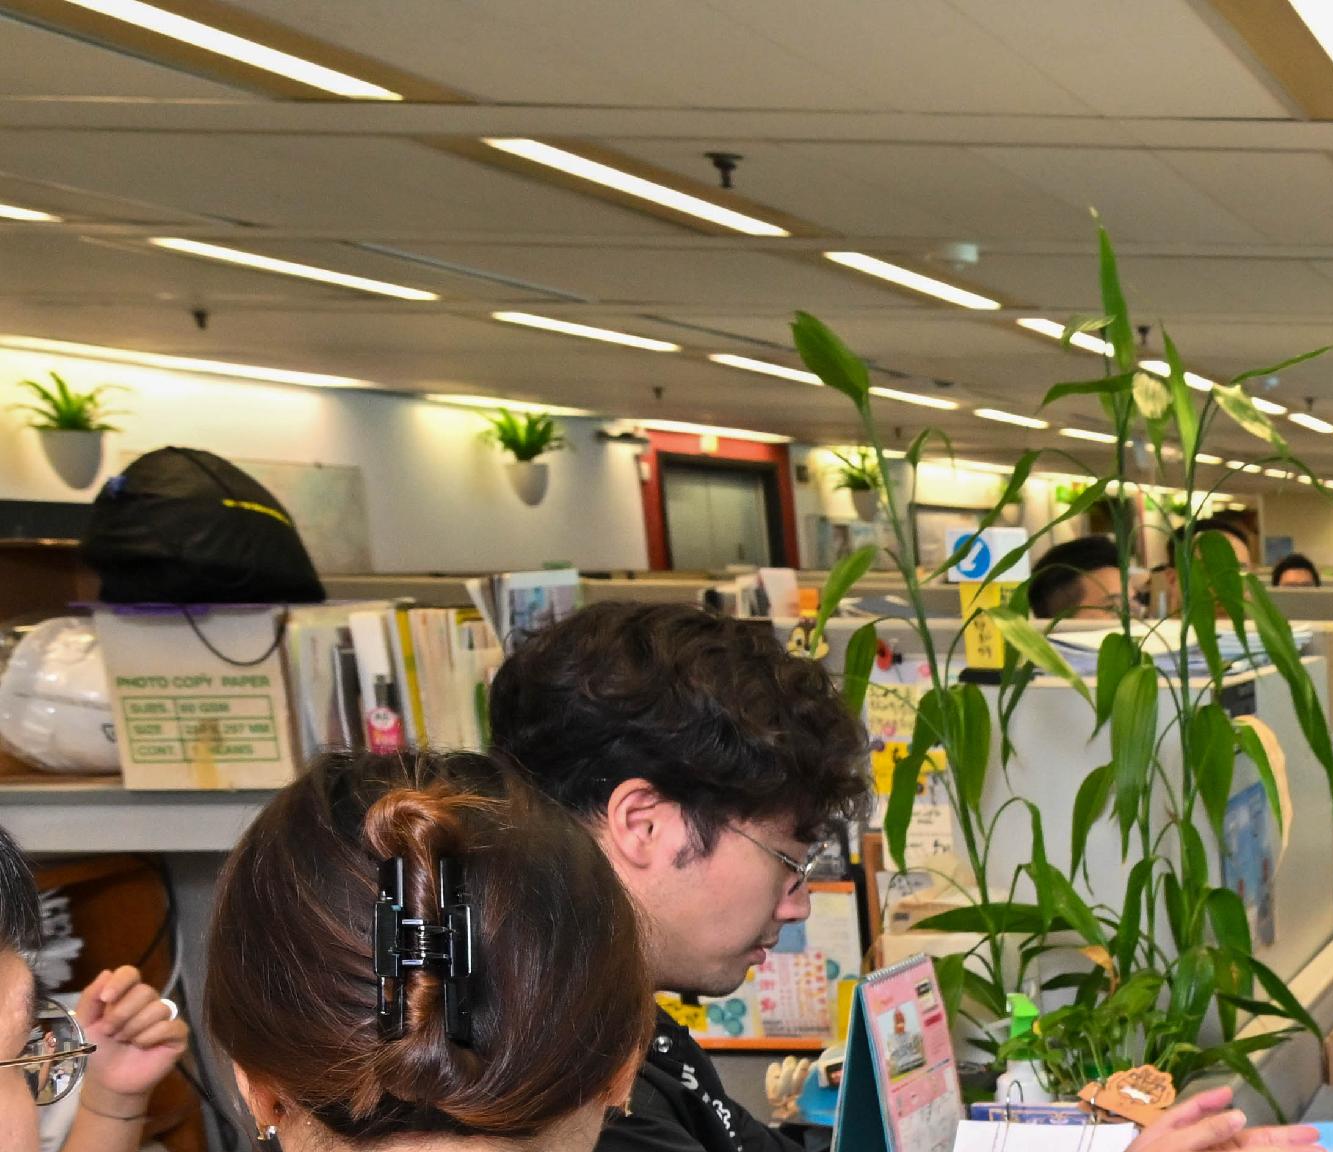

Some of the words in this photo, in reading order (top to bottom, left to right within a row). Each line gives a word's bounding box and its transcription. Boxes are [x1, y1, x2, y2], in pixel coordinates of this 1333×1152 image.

[116, 676, 168, 688] PHOTO
[172, 676, 212, 688] COPY
[221, 676, 271, 688] PAPER
